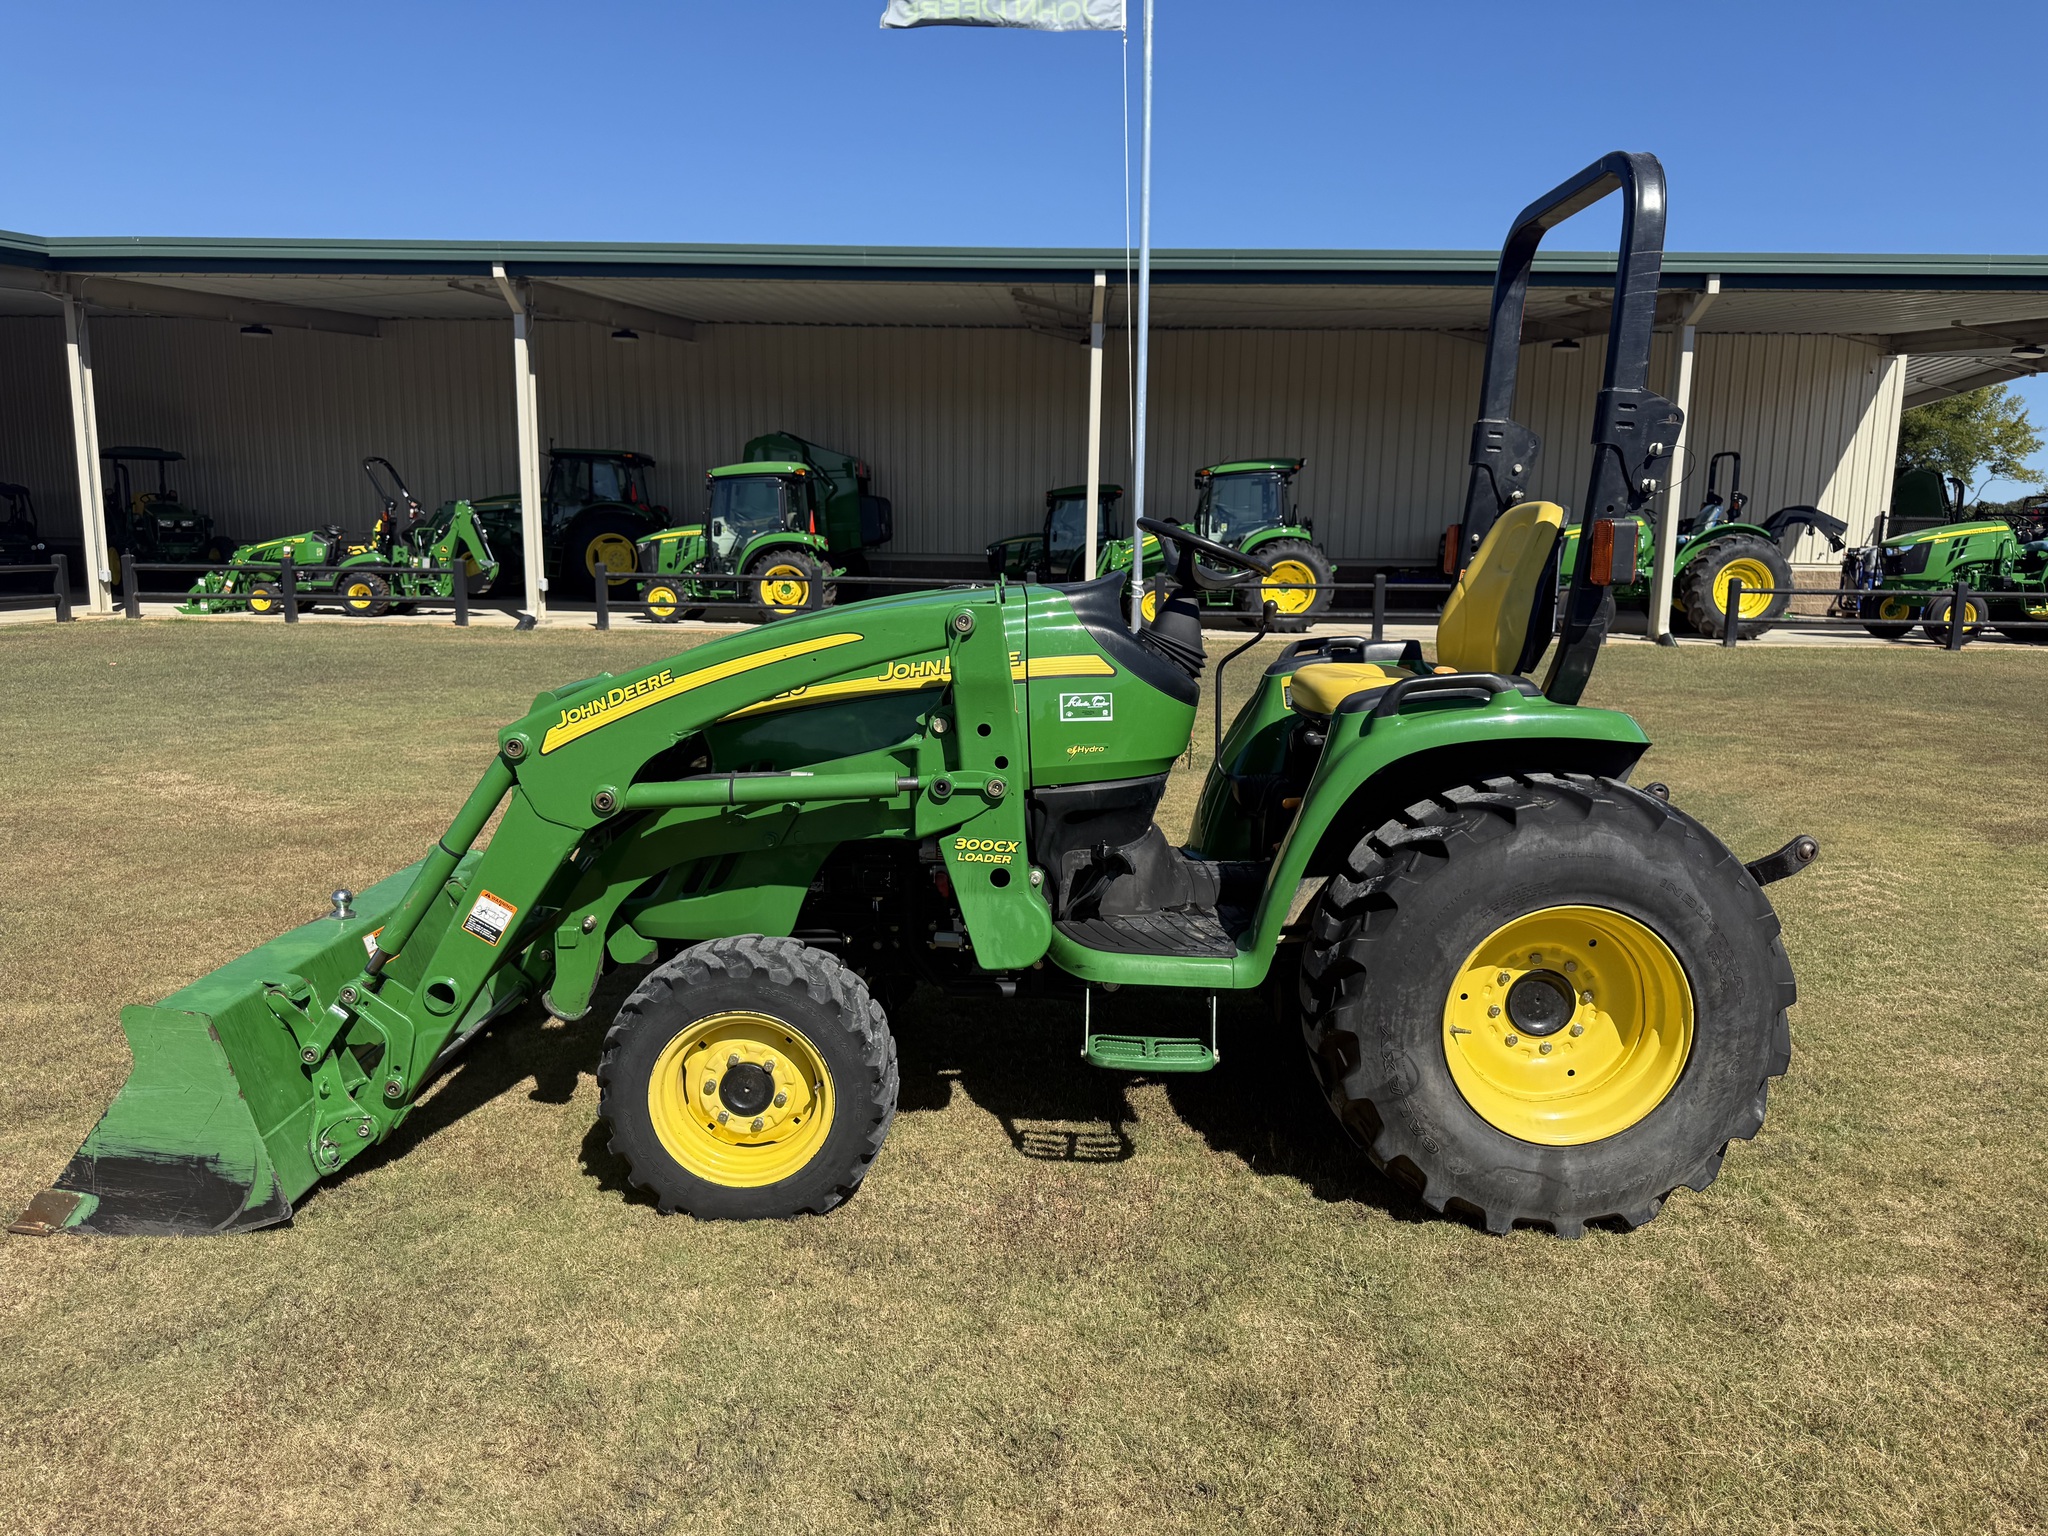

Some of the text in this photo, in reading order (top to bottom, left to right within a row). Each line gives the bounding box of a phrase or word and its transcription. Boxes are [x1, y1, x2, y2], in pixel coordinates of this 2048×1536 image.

[878, 660, 942, 681] JOHN
[556, 669, 675, 729] JOHN DEERE
[954, 837, 1020, 853] 300CX
[957, 852, 1012, 864] LOADER
[1659, 878, 1746, 1005] INDUSTRIAL
[1380, 1026, 1440, 1155] GALAXY
